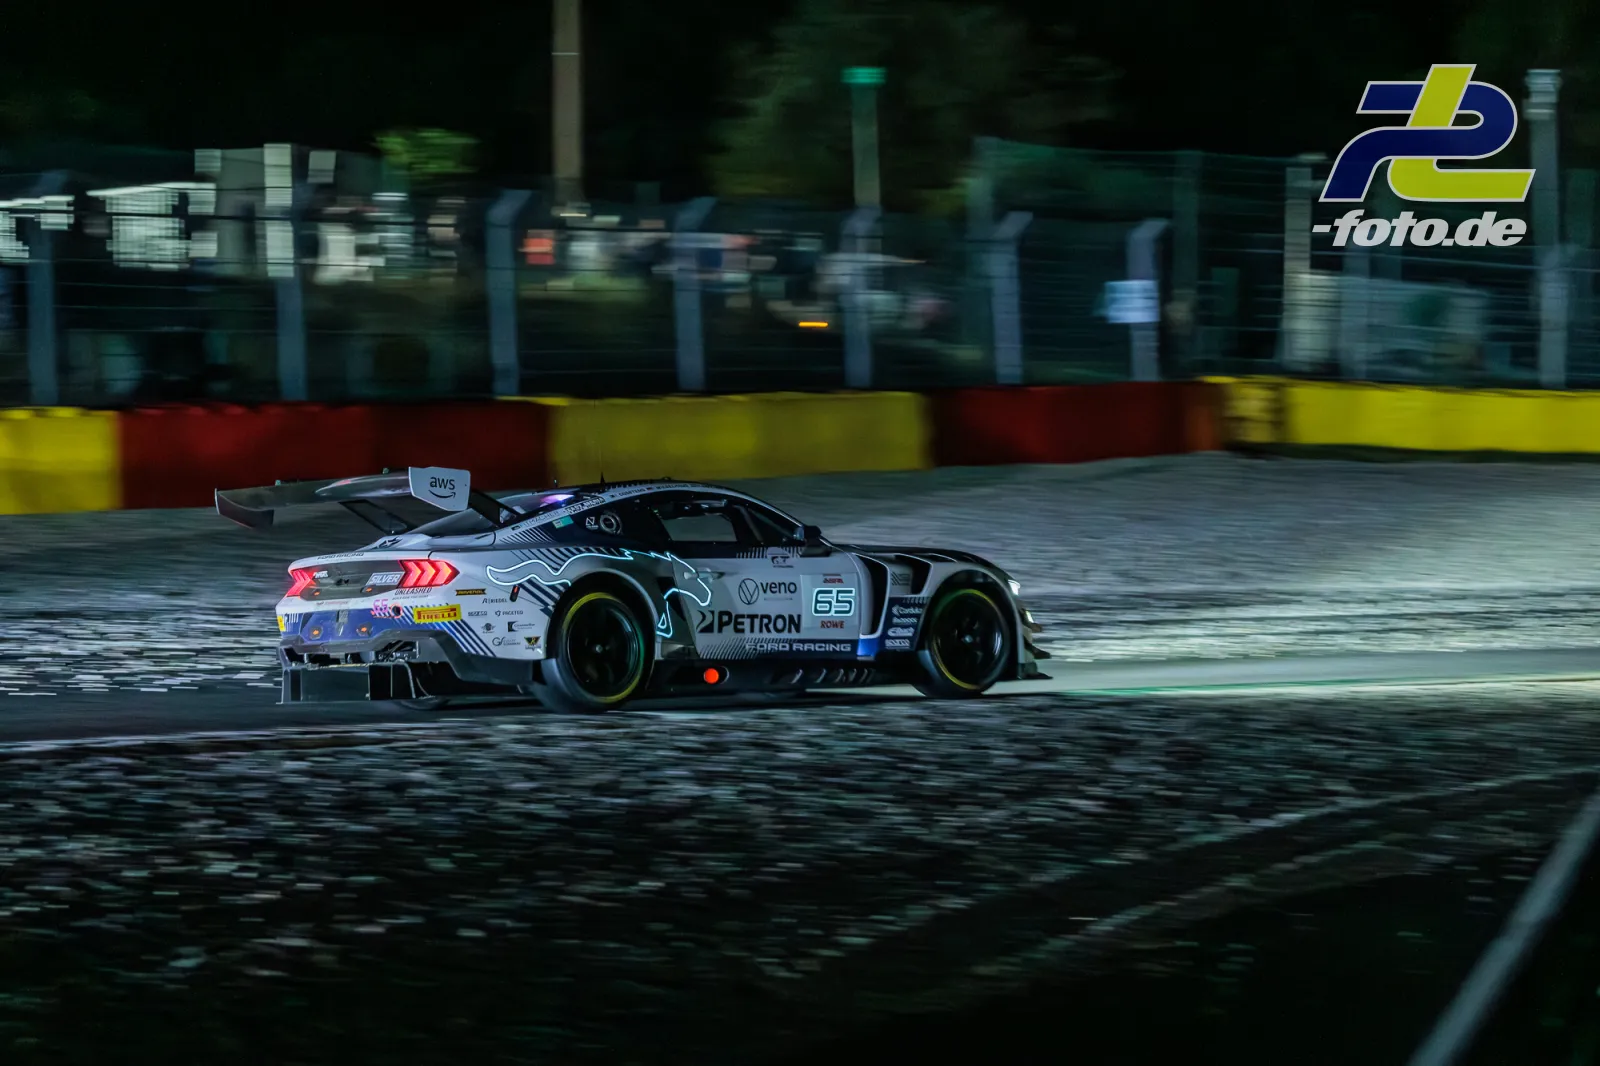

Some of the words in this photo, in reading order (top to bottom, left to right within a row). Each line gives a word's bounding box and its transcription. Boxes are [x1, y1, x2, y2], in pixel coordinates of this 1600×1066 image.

[430, 476, 455, 490] aws
[370, 574, 400, 584] SILVER
[394, 587, 433, 596] UNLEASHED
[760, 581, 798, 594] veno
[811, 587, 855, 617] 65
[416, 607, 457, 620] PIRELLI
[717, 610, 801, 634] PETRON
[820, 620, 845, 629] ROWE
[745, 643, 790, 652] FORD
[792, 643, 852, 652] RACING
